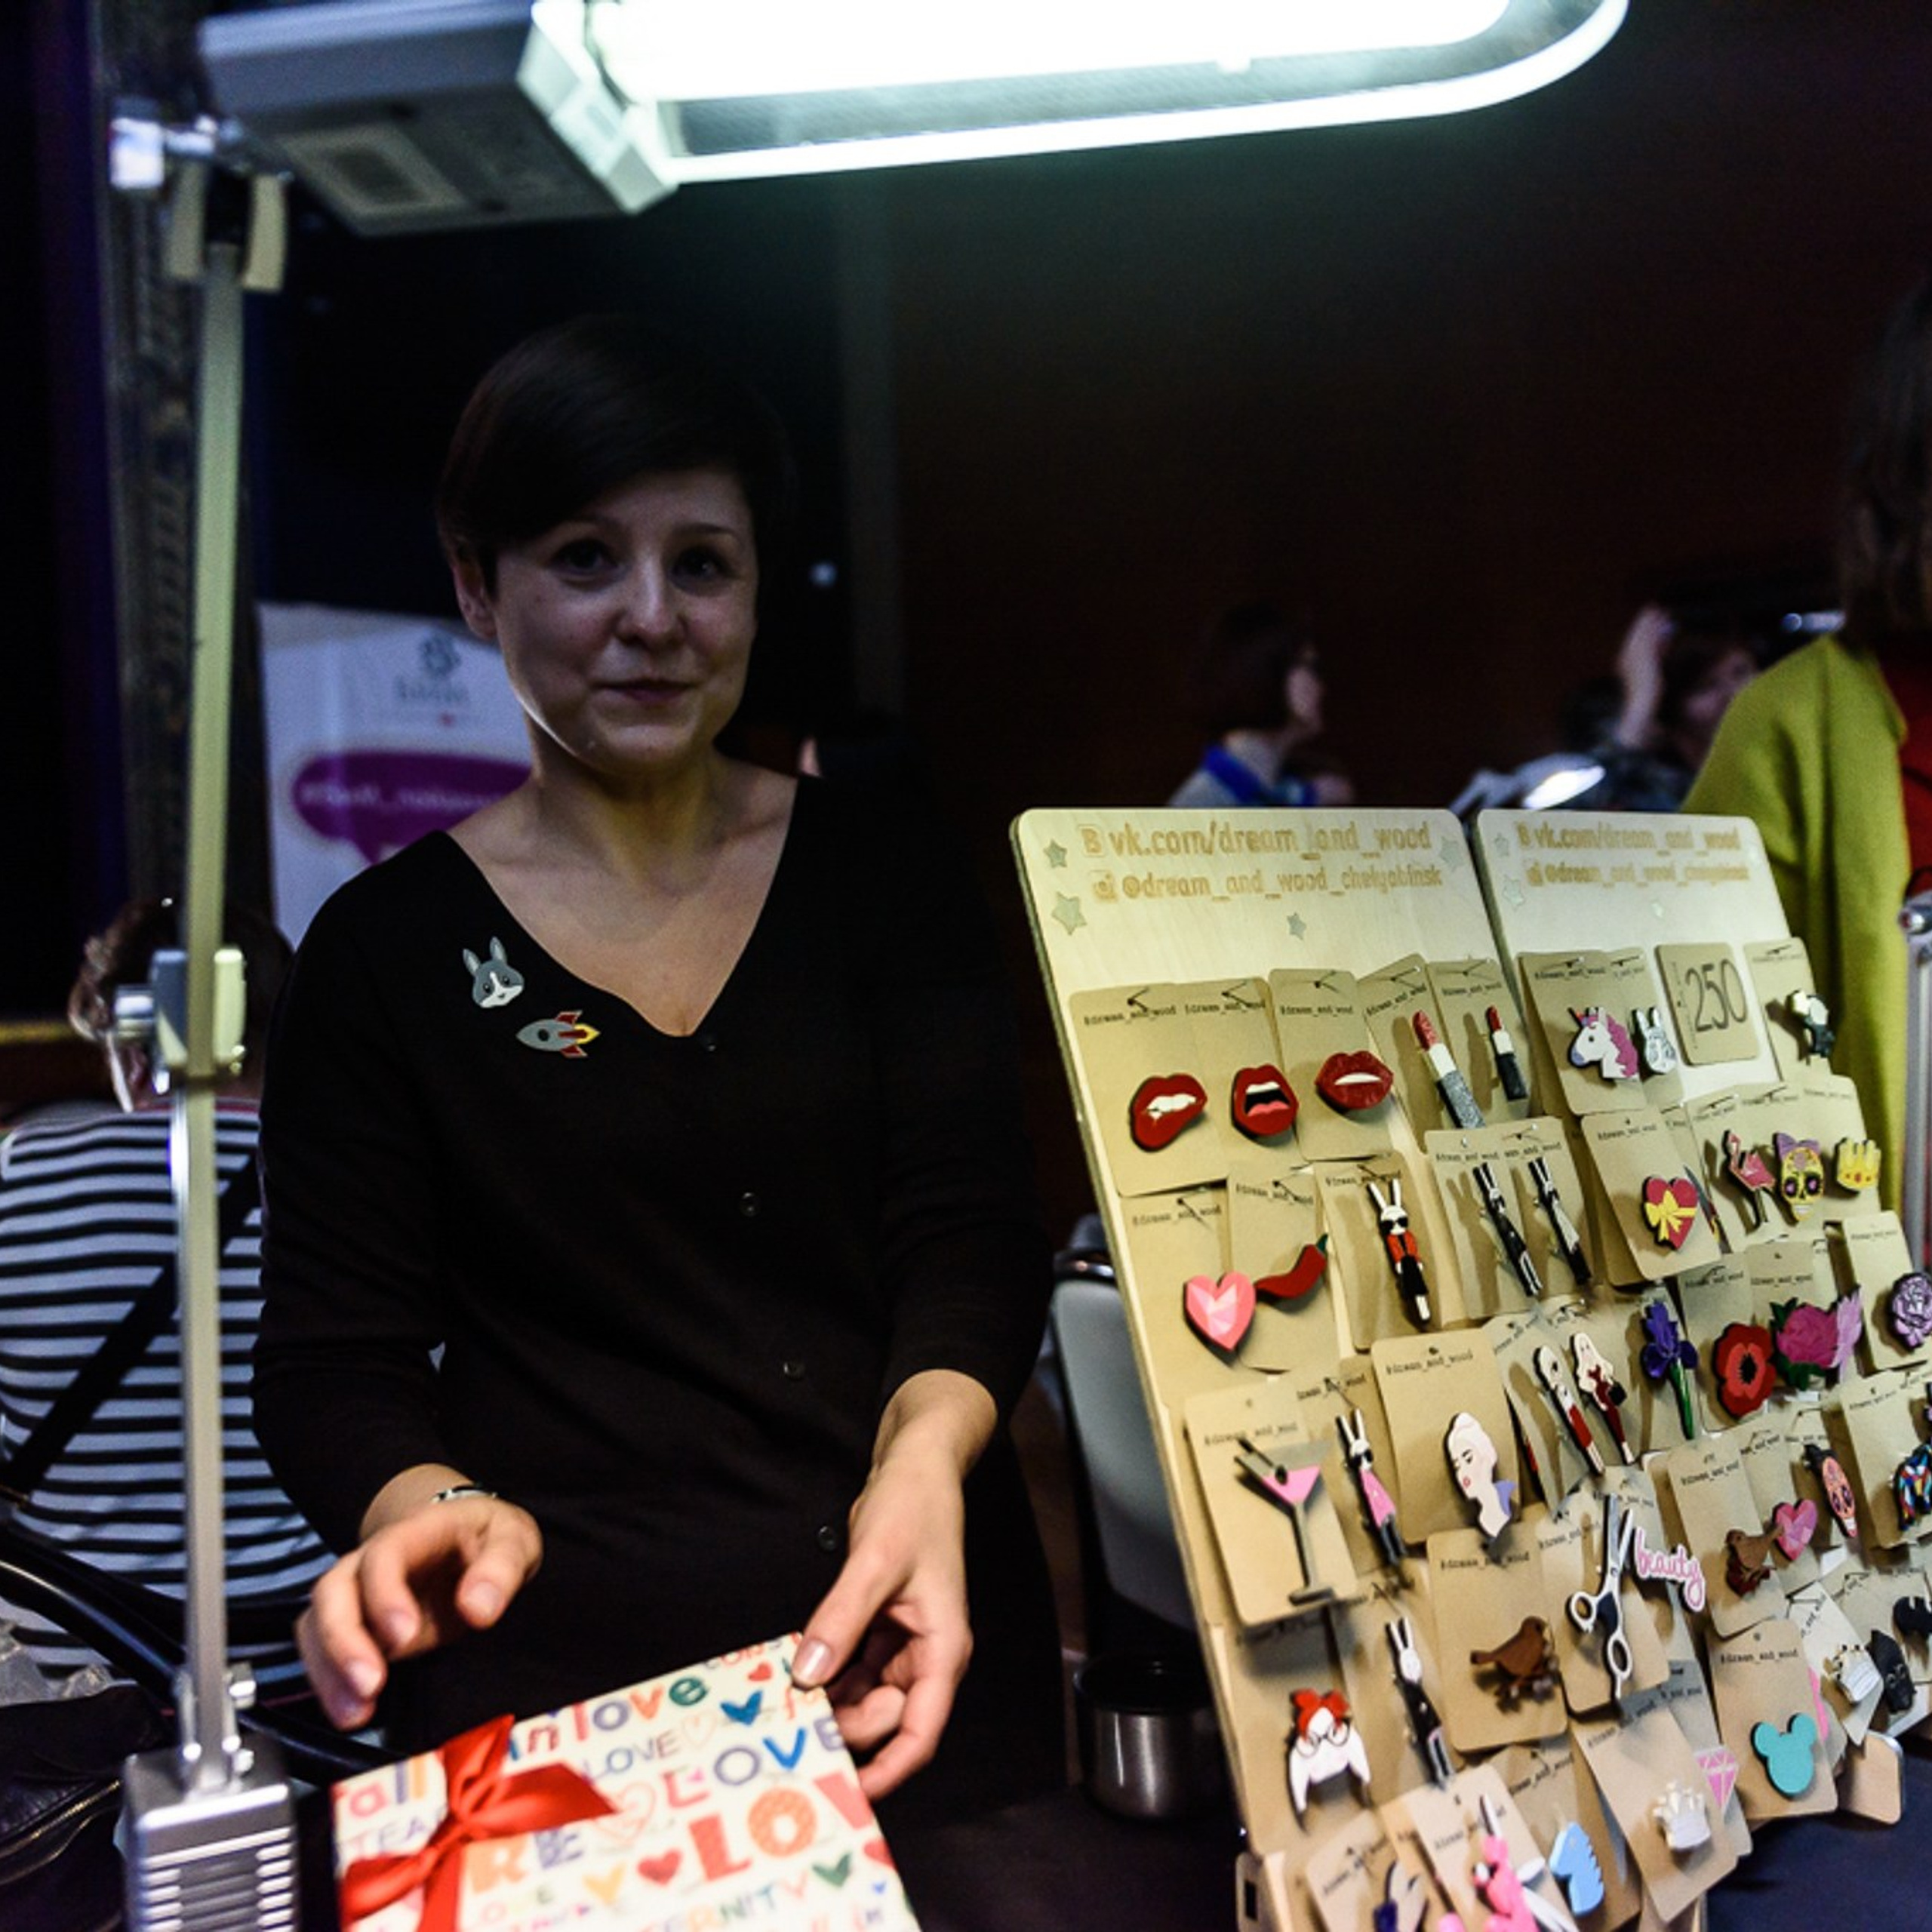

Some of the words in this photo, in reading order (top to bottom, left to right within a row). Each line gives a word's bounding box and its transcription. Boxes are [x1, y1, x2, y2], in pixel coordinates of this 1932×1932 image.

[1108, 820, 1433, 861] vk.com/dream_and_wood
[1684, 958, 1748, 1032] 250
[571, 1673, 710, 1742] love
